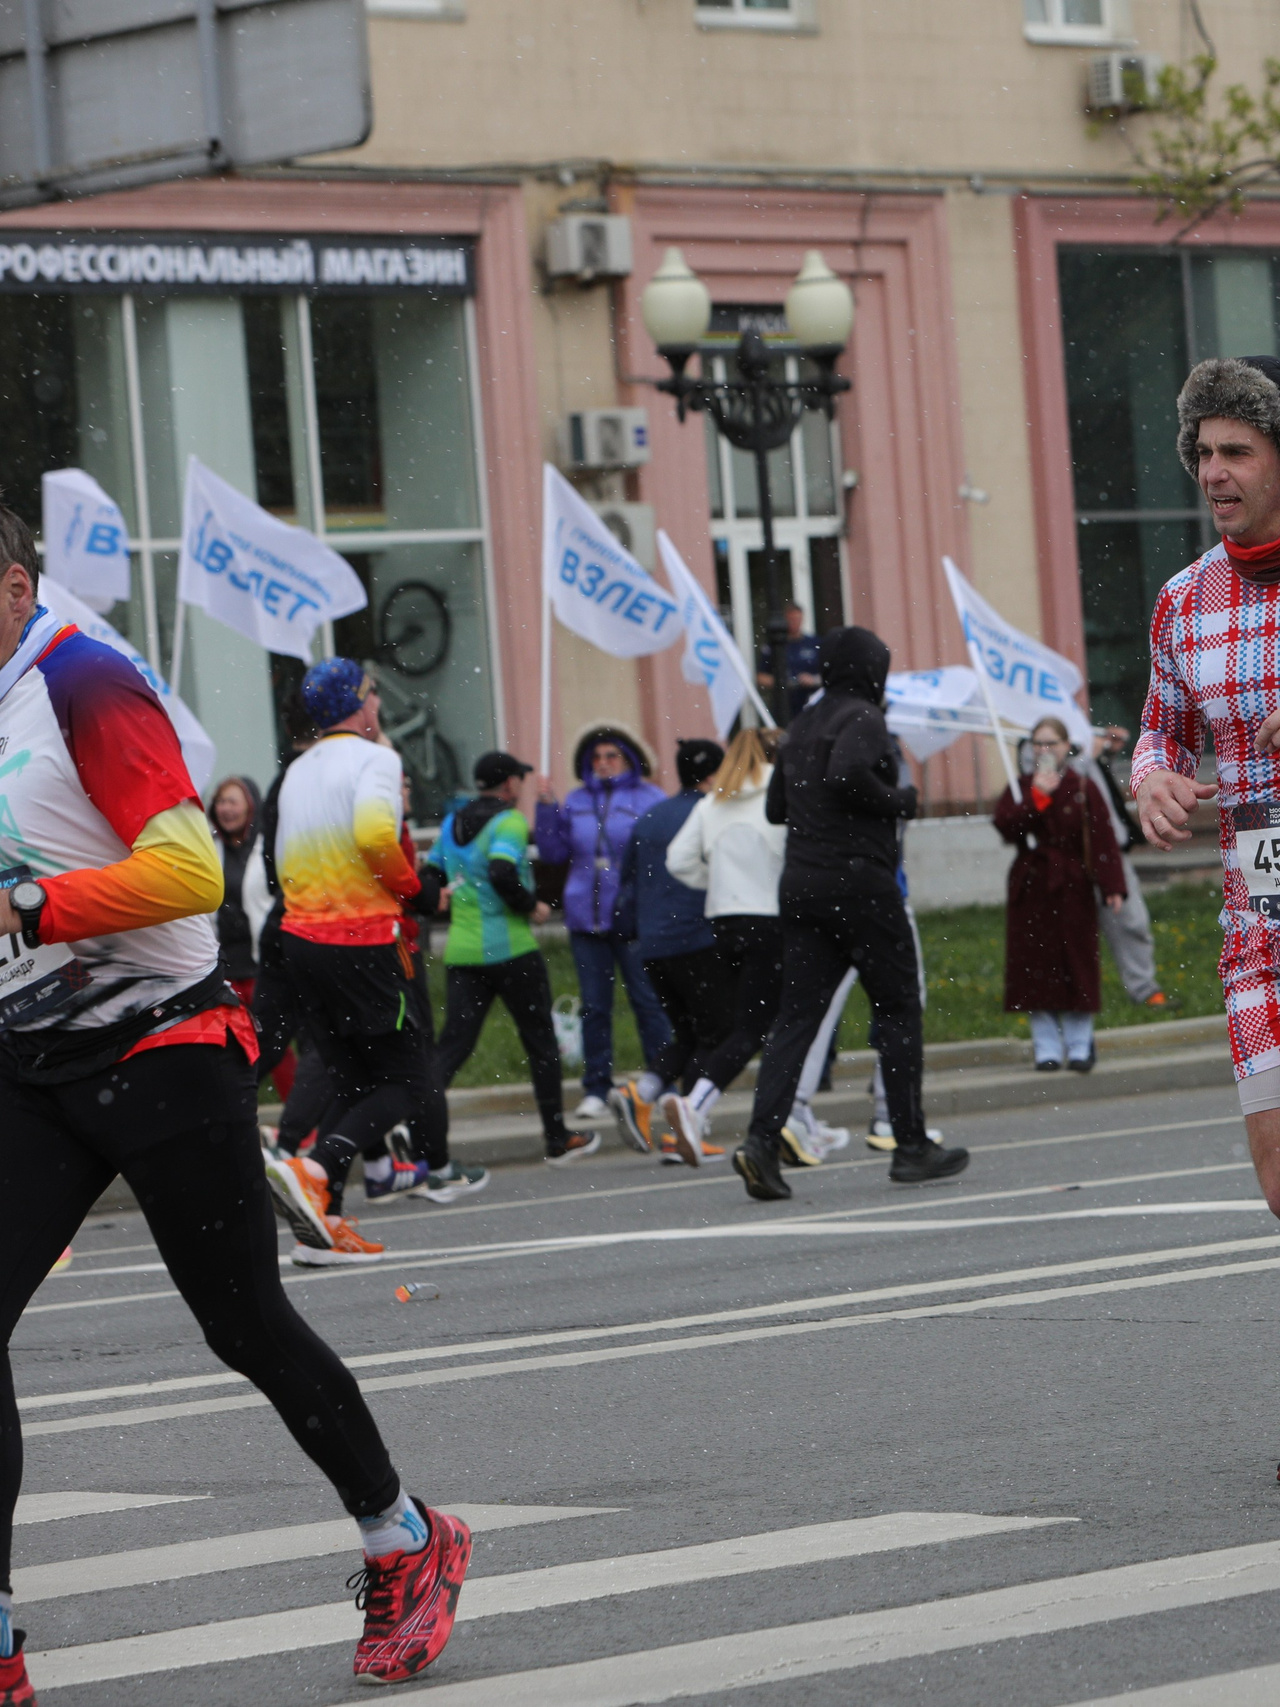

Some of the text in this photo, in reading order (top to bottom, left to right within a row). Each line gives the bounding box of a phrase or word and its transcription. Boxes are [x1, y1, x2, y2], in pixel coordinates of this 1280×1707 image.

[322, 248, 467, 284] МАГАЗИН
[84, 521, 132, 558] В
[559, 547, 678, 635] ВЗЛЕТ
